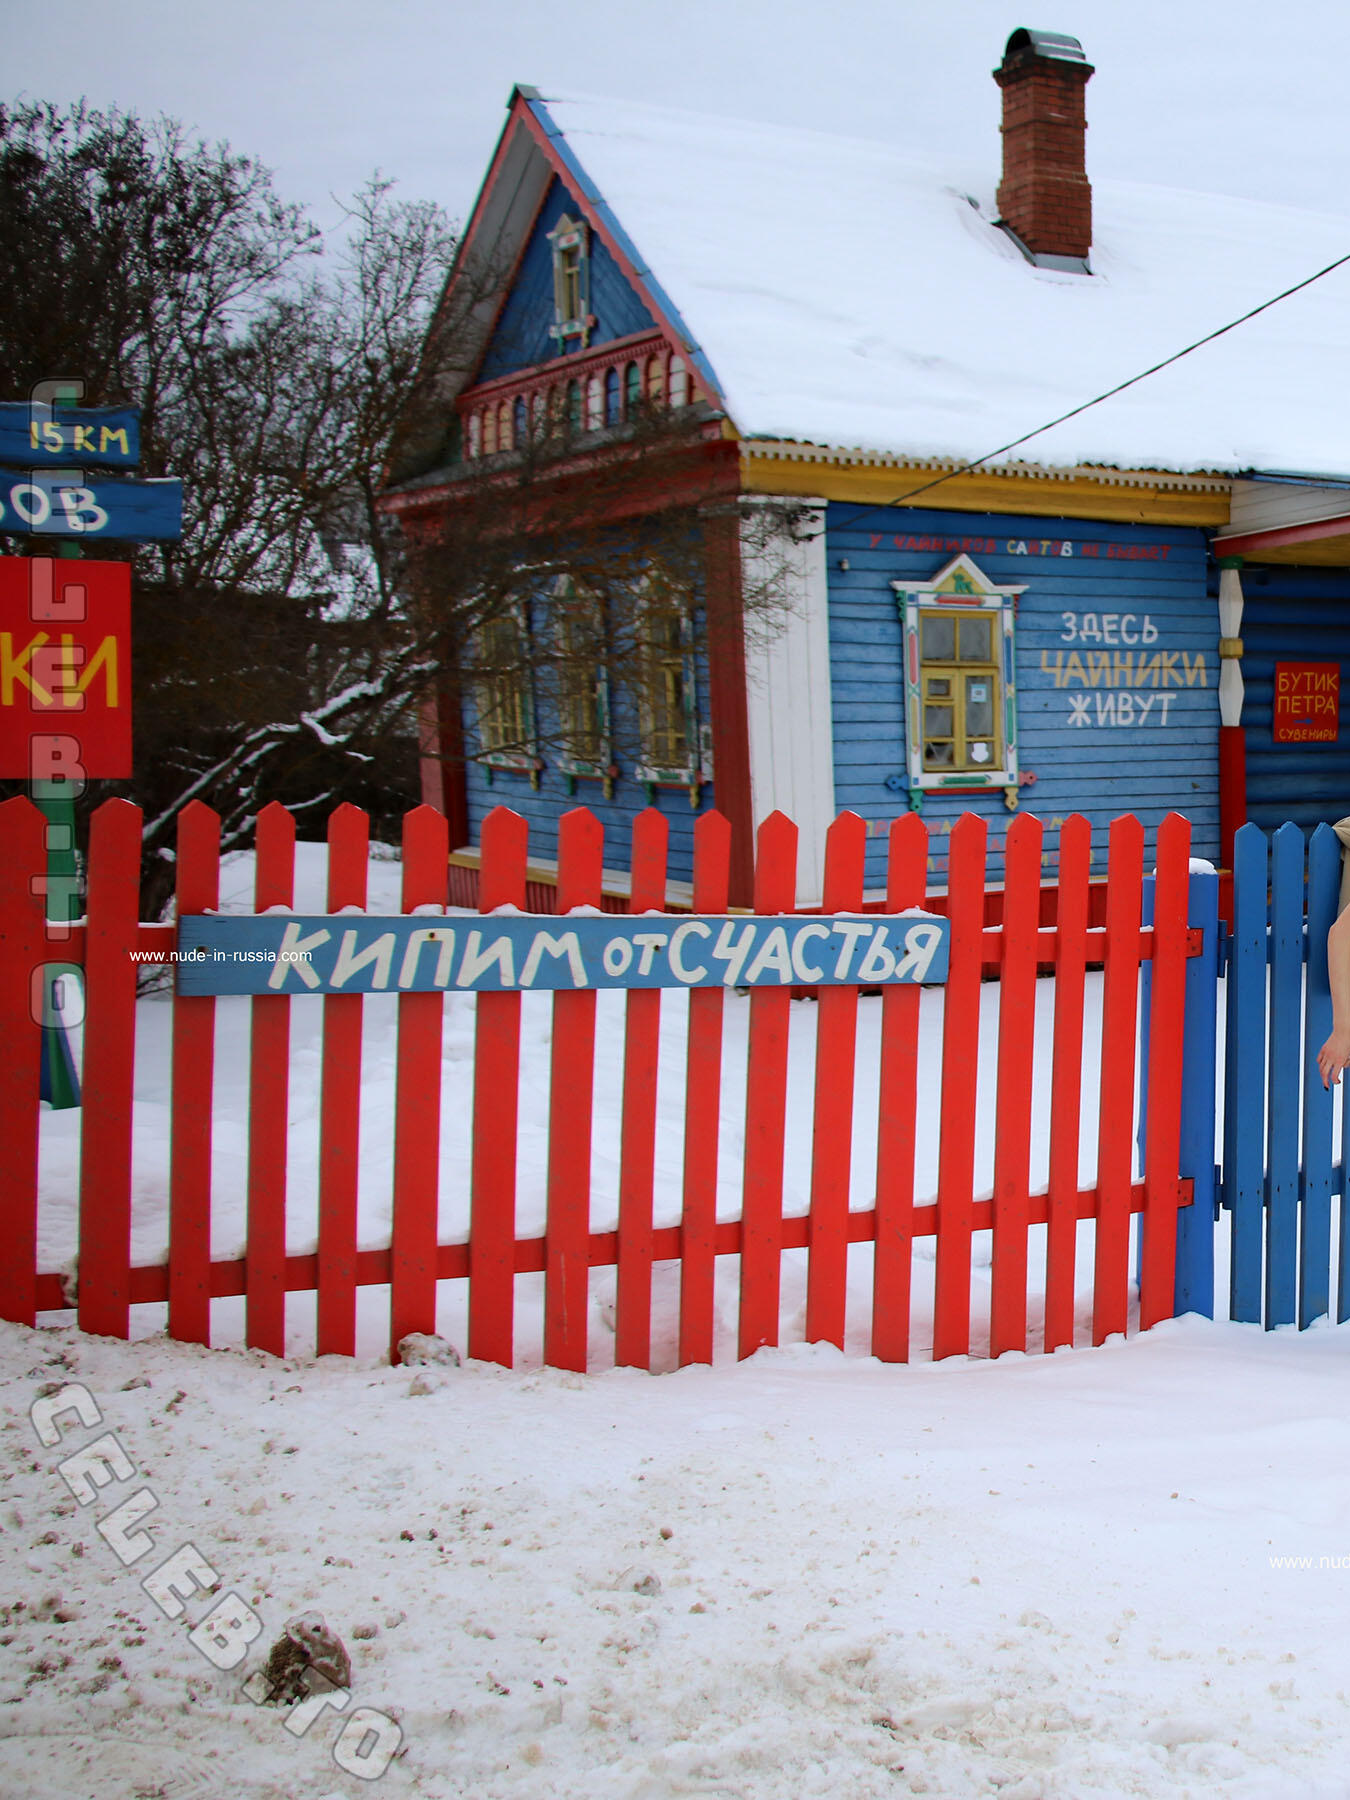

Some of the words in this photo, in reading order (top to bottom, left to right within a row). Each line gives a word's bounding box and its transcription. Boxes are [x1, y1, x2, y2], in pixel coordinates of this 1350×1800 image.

[30, 421, 64, 453] 15
[74, 425, 130, 455] КМ
[0, 483, 108, 532] ОВ
[1060, 611, 1159, 645] ЗДЕСЬ
[1040, 650, 1208, 688] ЧАЙНИКИ
[1278, 671, 1338, 692] БУТИК
[1066, 692, 1177, 727] ЖИВУТ
[1277, 695, 1336, 716] ПЕТРА
[1278, 728, 1337, 741] СУВЕНИРЫ
[267, 921, 588, 989] КИПИМ
[668, 920, 943, 987] СЧАСТЬЯ
